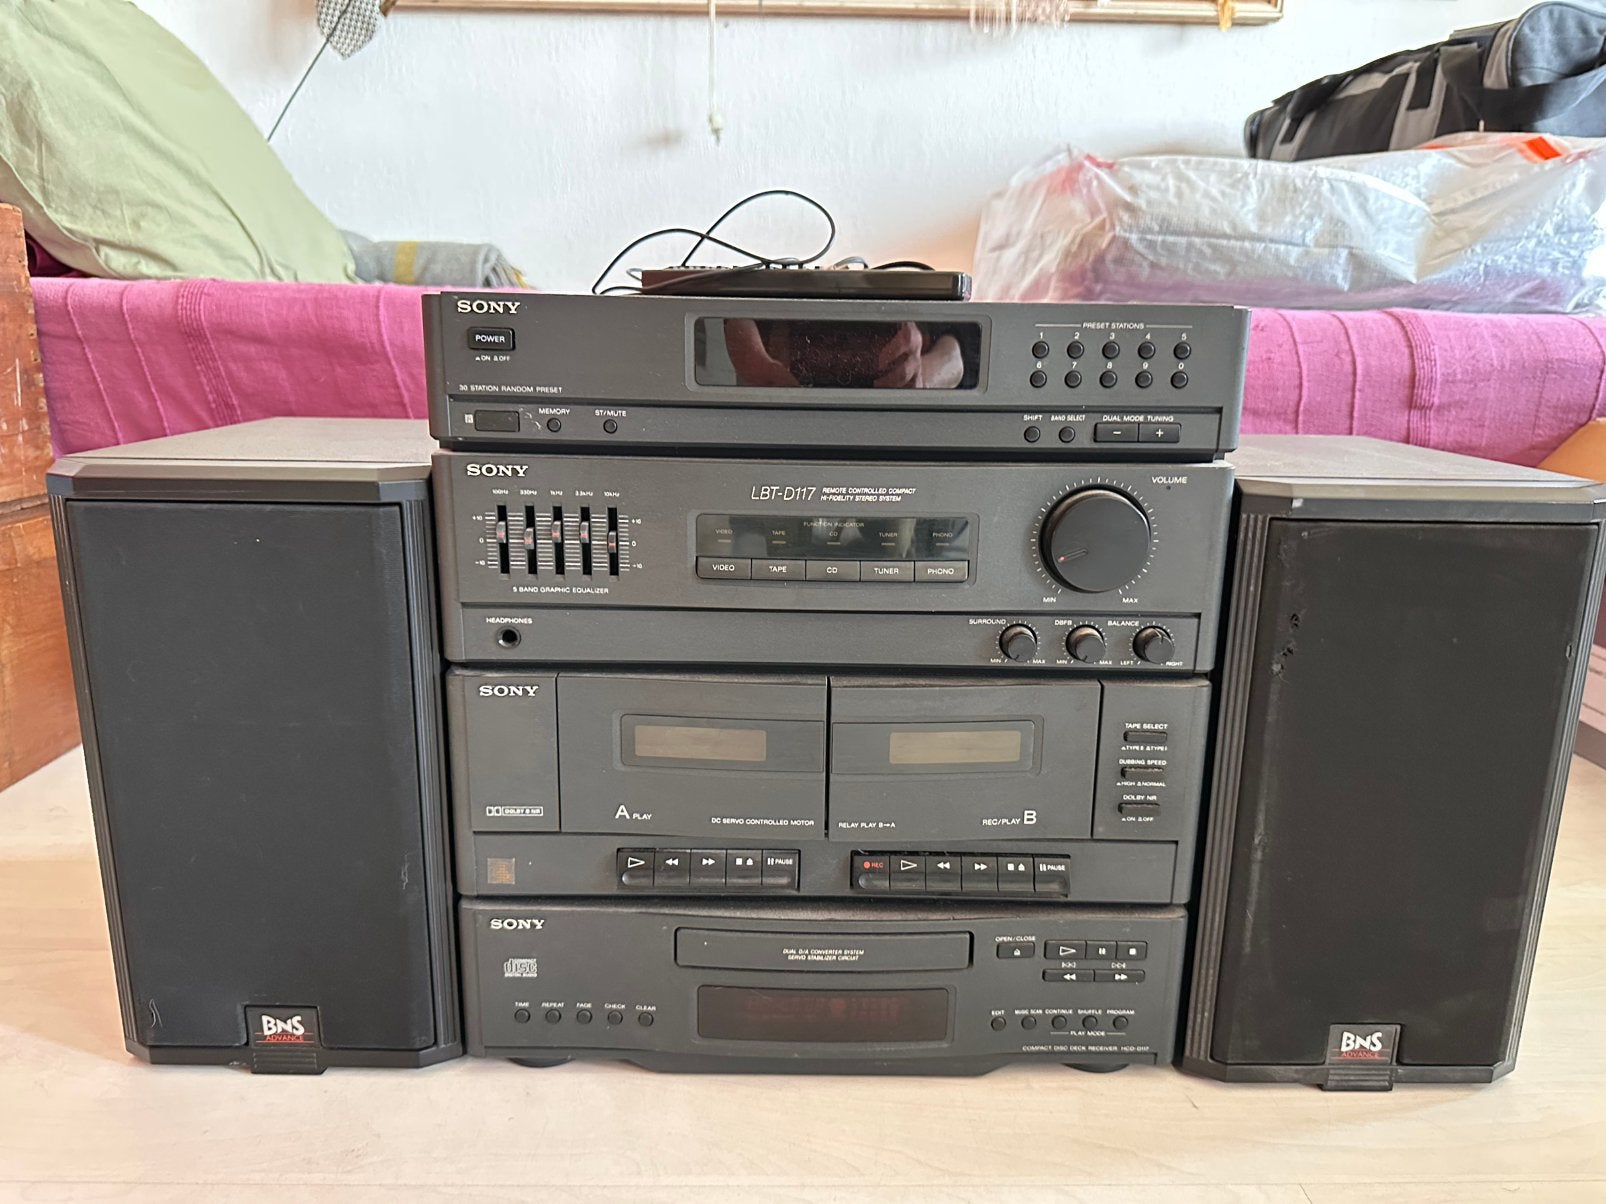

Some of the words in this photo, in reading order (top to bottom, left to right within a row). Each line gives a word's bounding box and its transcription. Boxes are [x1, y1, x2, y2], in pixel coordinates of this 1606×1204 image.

[457, 300, 520, 314] SONY
[476, 334, 505, 343] POWER
[466, 464, 528, 476] SONY
[751, 486, 816, 500] LBT-D117
[479, 686, 539, 697] SONY
[615, 805, 630, 819] A
[982, 818, 1020, 826] REC/PLAY
[1024, 810, 1036, 824] B
[490, 919, 545, 930] SONY
[262, 1015, 304, 1035] BNS
[1341, 1031, 1382, 1051] BNS
